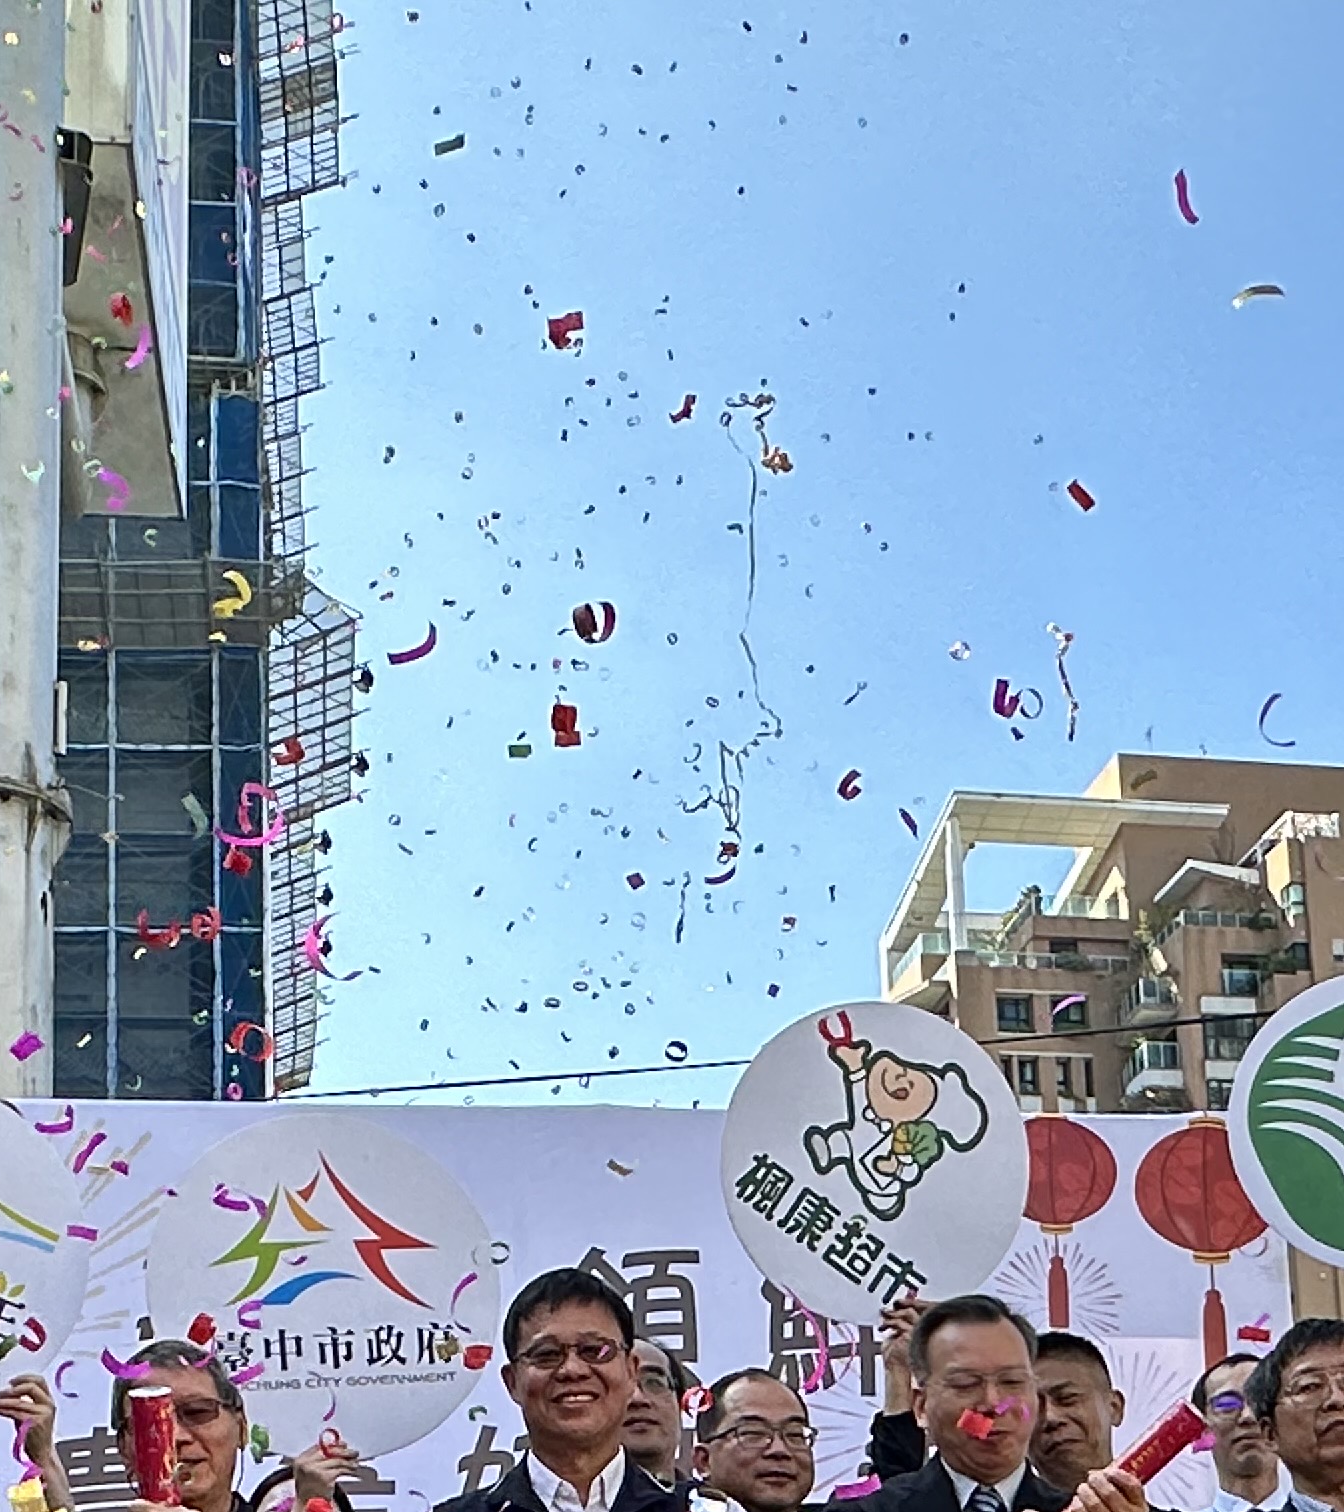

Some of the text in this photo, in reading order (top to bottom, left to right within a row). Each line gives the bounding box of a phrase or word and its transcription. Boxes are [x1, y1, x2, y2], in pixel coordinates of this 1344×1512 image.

[735, 1152, 928, 1305] 楓康超市
[216, 1321, 457, 1372] 臺中市政府
[345, 1371, 457, 1387] GOVERNMENT
